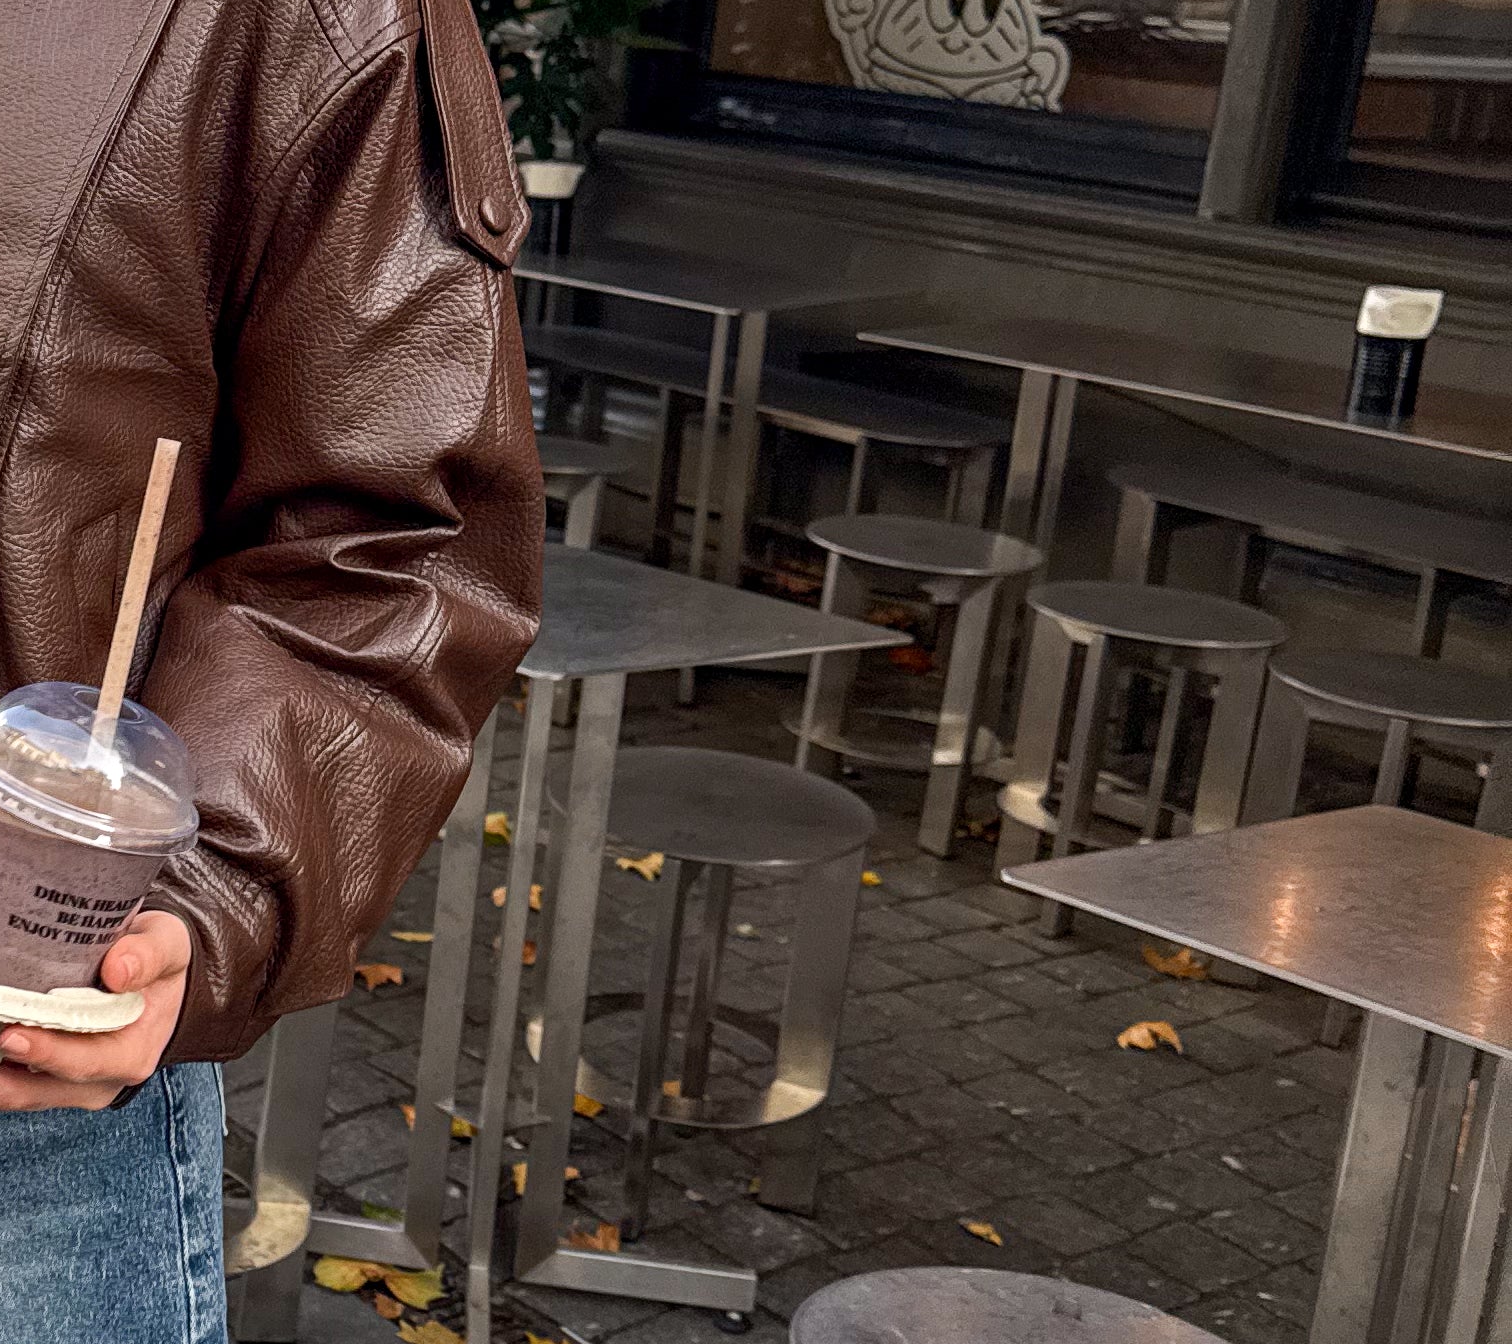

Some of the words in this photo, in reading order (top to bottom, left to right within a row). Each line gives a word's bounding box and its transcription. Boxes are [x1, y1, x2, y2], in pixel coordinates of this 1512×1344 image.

[33, 885, 93, 911] DRINK
[91, 894, 144, 913] HEALT
[7, 913, 63, 941] ENJOY
[63, 929, 95, 945] THE
[55, 910, 80, 927] BE
